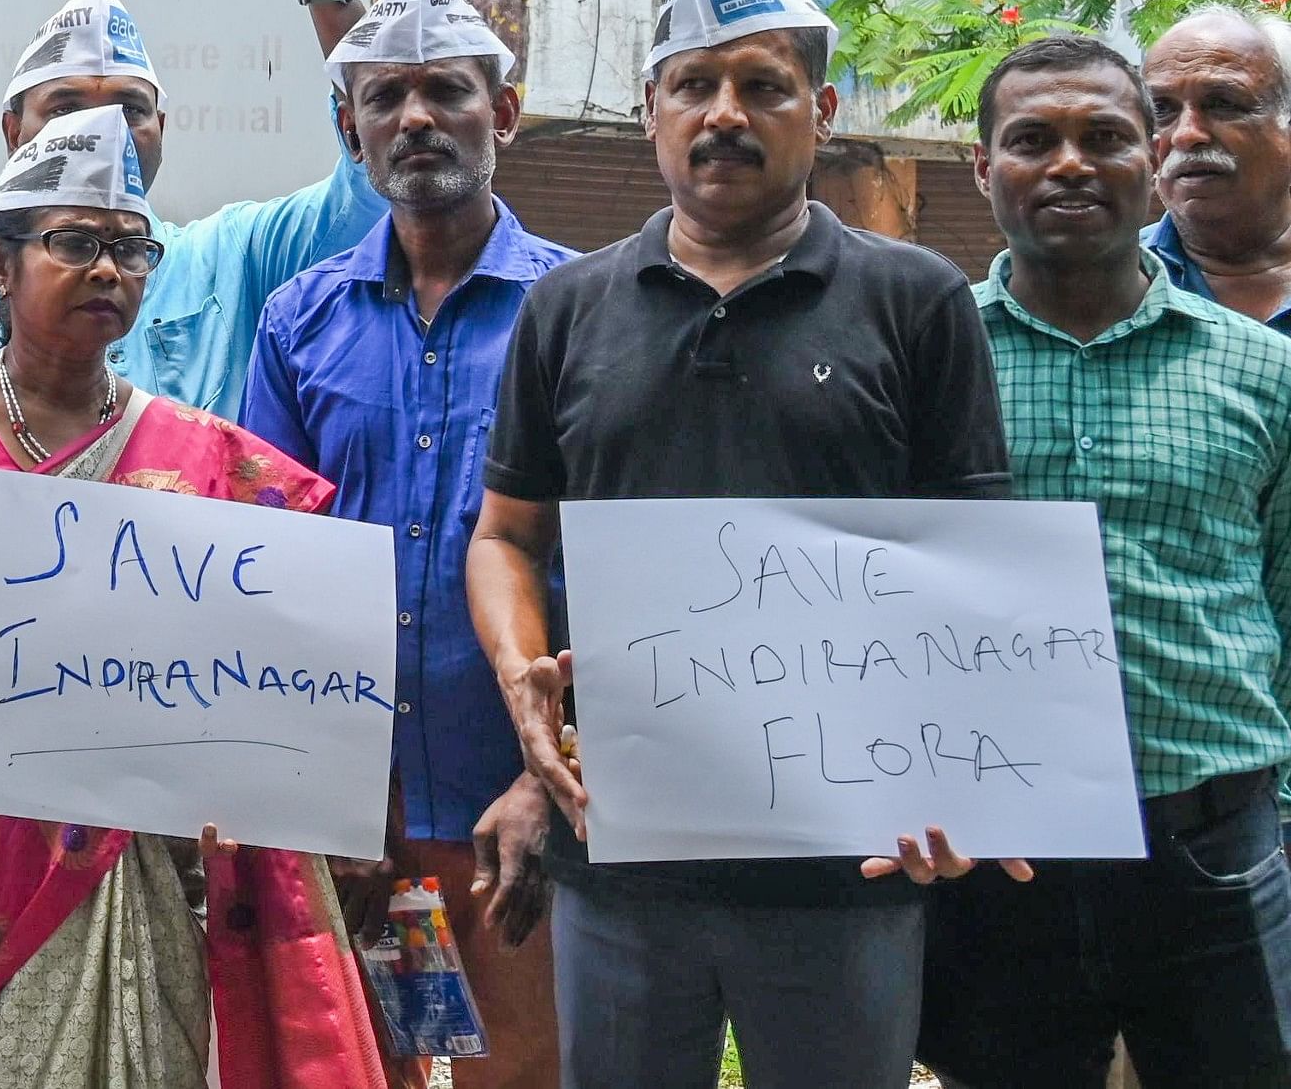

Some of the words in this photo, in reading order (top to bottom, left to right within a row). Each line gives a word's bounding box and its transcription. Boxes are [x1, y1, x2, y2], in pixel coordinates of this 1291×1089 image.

[48, 6, 93, 33] PARTY
[369, 1, 407, 17] PARTY
[3, 499, 275, 602] SAVE
[688, 520, 916, 614] SAVE
[627, 622, 1120, 710] INDIRANAGAR
[762, 711, 1043, 811] FLORA
